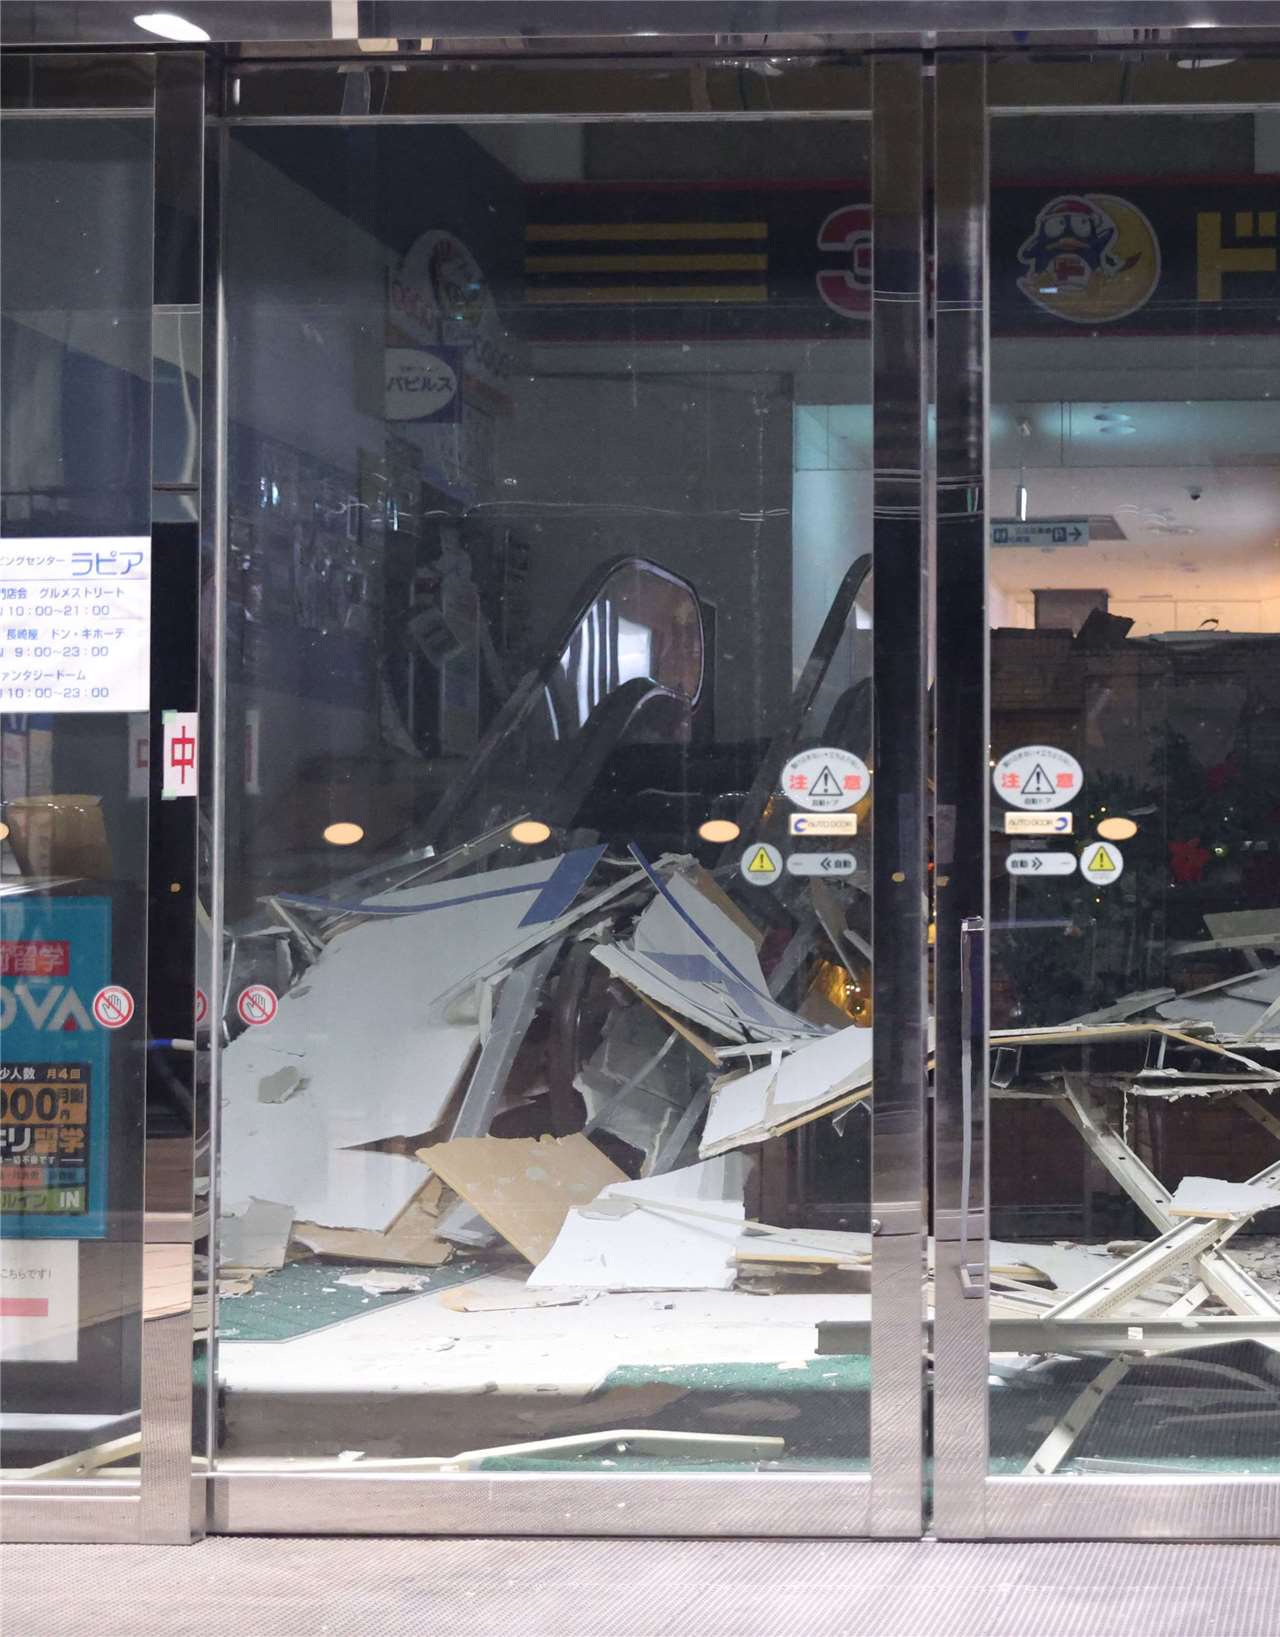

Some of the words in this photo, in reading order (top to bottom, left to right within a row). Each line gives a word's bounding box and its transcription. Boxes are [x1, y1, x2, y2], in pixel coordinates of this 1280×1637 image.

[71, 550, 144, 576] ラピア
[39, 587, 125, 600] グルメストリート
[6, 628, 38, 641] 長崎屋
[51, 628, 125, 640] ドン・キホーテ
[171, 725, 195, 784] 中
[834, 858, 853, 869] 自動
[1010, 859, 1029, 869] 自動
[59, 1190, 81, 1209] IN
